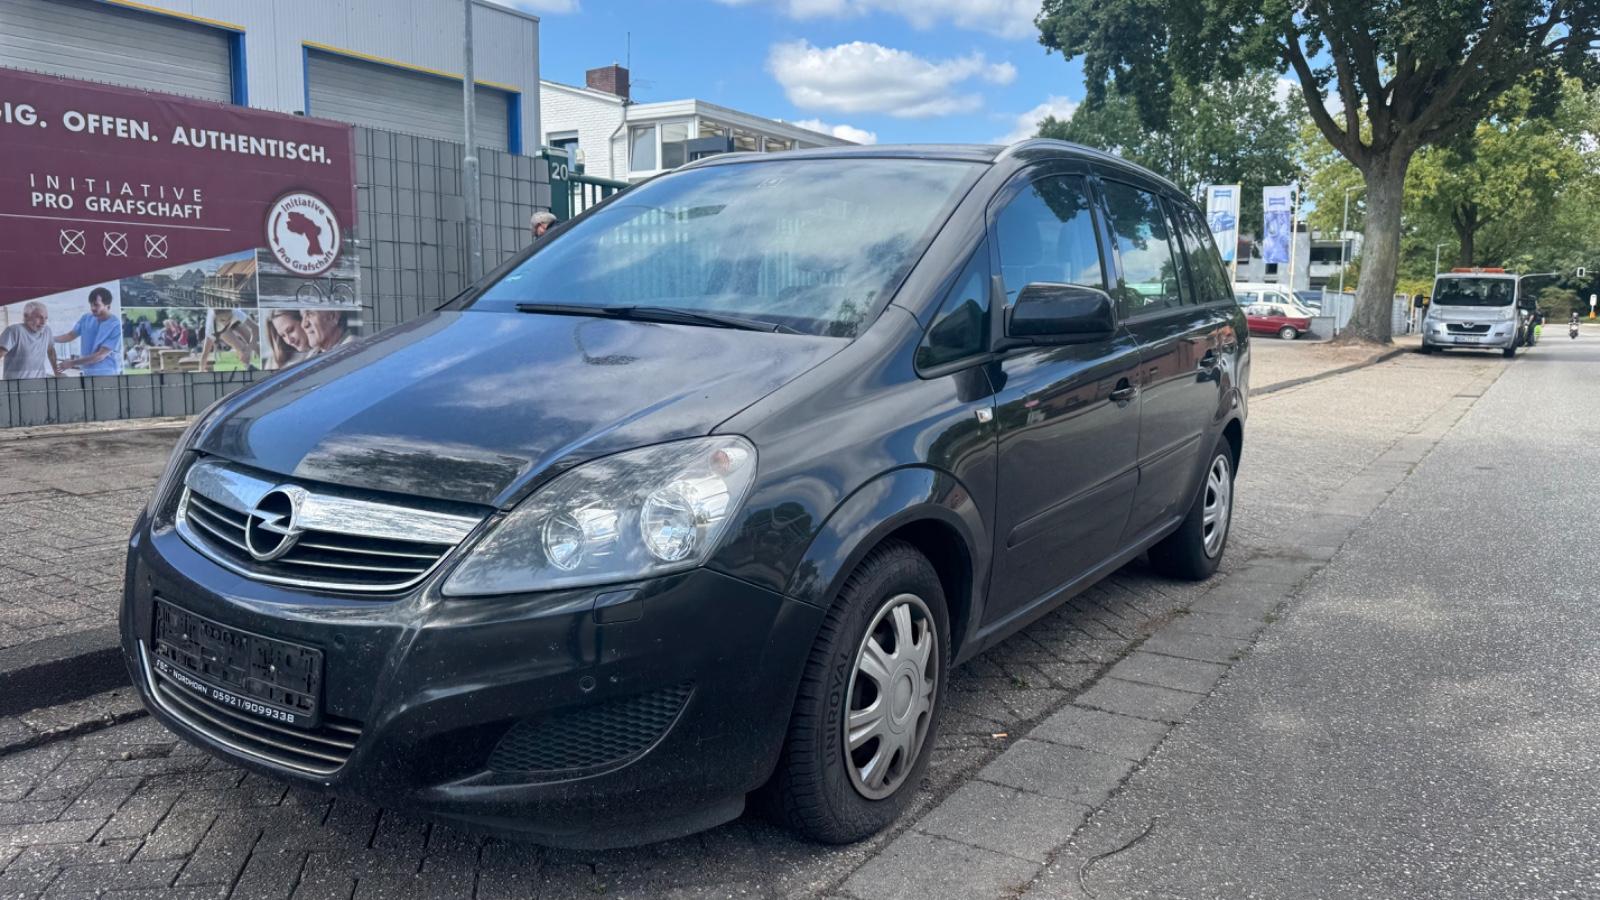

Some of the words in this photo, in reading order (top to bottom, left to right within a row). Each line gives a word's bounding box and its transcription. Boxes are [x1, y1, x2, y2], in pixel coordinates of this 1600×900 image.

[0, 101, 47, 128] IG.
[63, 111, 158, 142] OFFEN.
[171, 126, 332, 165] AUTHENTISCH.
[551, 162, 568, 181] 20
[30, 173, 203, 202] INITIATIVE
[31, 192, 74, 210] PRO
[85, 196, 202, 220] GRAFSCHAFT
[281, 197, 325, 215] Initiative
[277, 248, 291, 264] Pro
[292, 250, 334, 271] Grafschaft
[173, 669, 208, 694] NORDHORN
[826, 648, 853, 767] UNIROYAL
